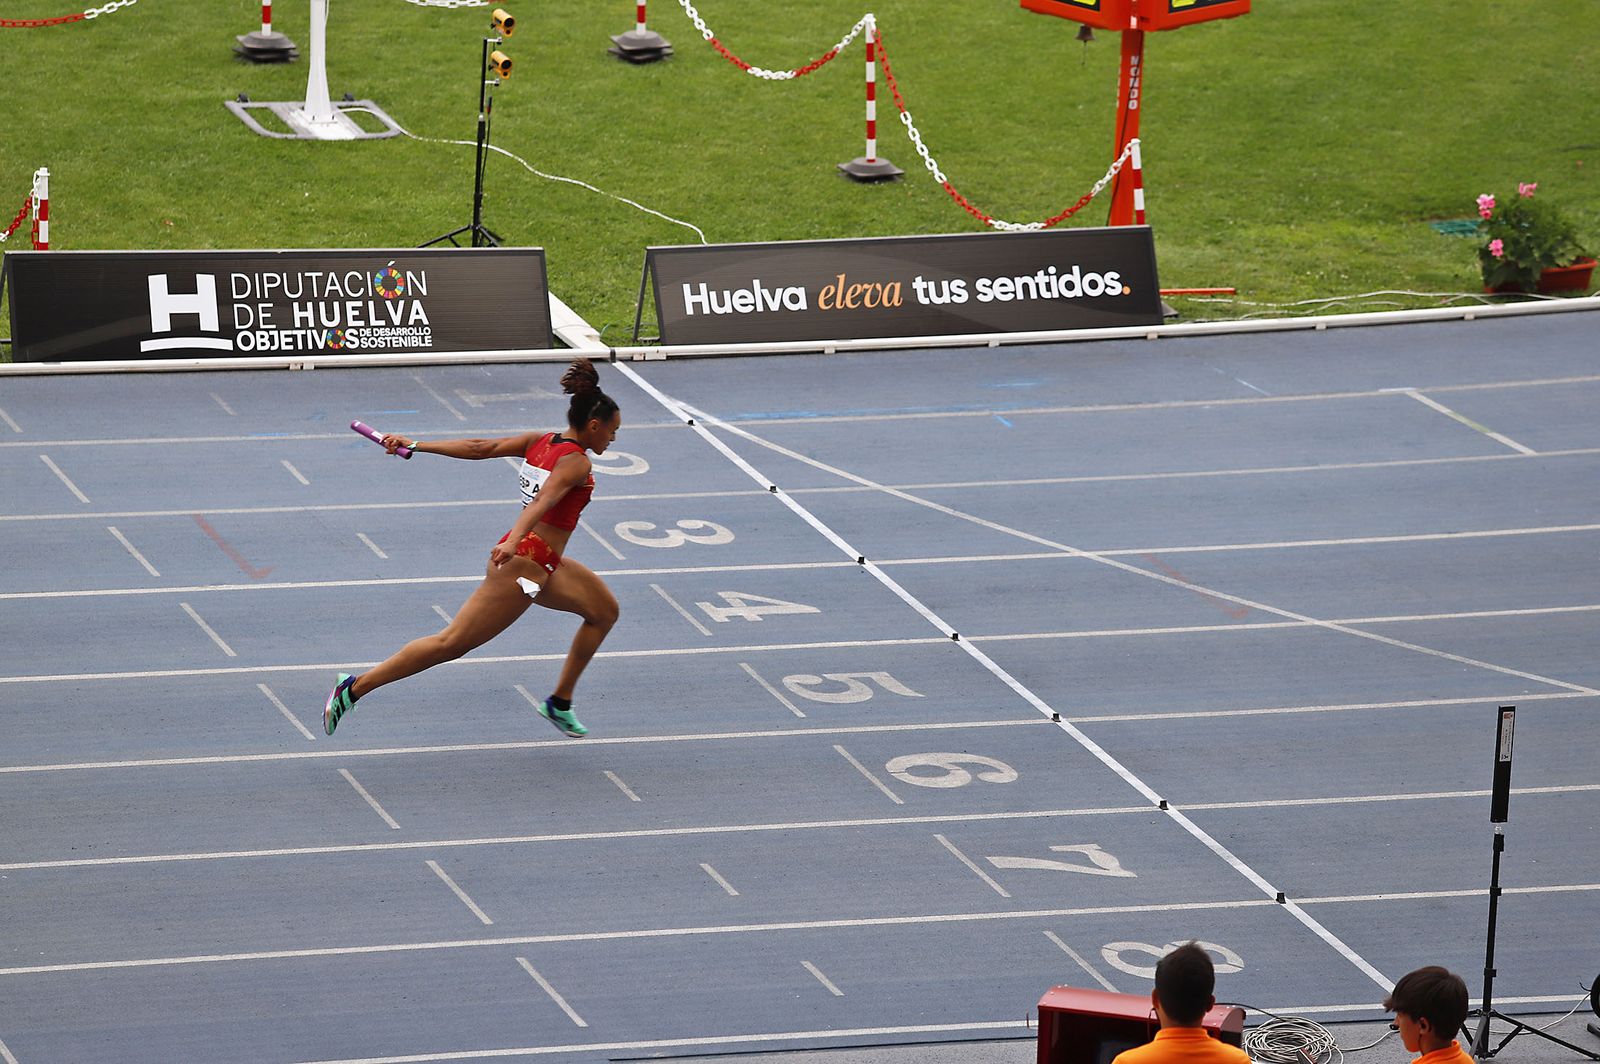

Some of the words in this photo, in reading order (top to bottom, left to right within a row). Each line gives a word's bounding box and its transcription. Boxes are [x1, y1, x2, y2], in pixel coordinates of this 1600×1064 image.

[231, 261, 428, 299] DIPUTACIÓN
[682, 279, 808, 316] Huelva
[818, 274, 903, 310] eleva
[912, 274, 969, 306] tus
[975, 265, 1132, 302] sentidos.
[233, 303, 276, 329] DE
[294, 300, 429, 328] HUELVA
[236, 328, 360, 351] OBJETIVOS
[360, 328, 373, 337] DE
[374, 327, 431, 337] DESARROLLO
[360, 336, 432, 348] SOSTENIBLE
[614, 519, 736, 548] 3
[695, 591, 822, 623] 4
[782, 671, 926, 704] 5
[885, 752, 1019, 788] 6
[985, 843, 1138, 878] 7
[1101, 939, 1245, 979] 8
